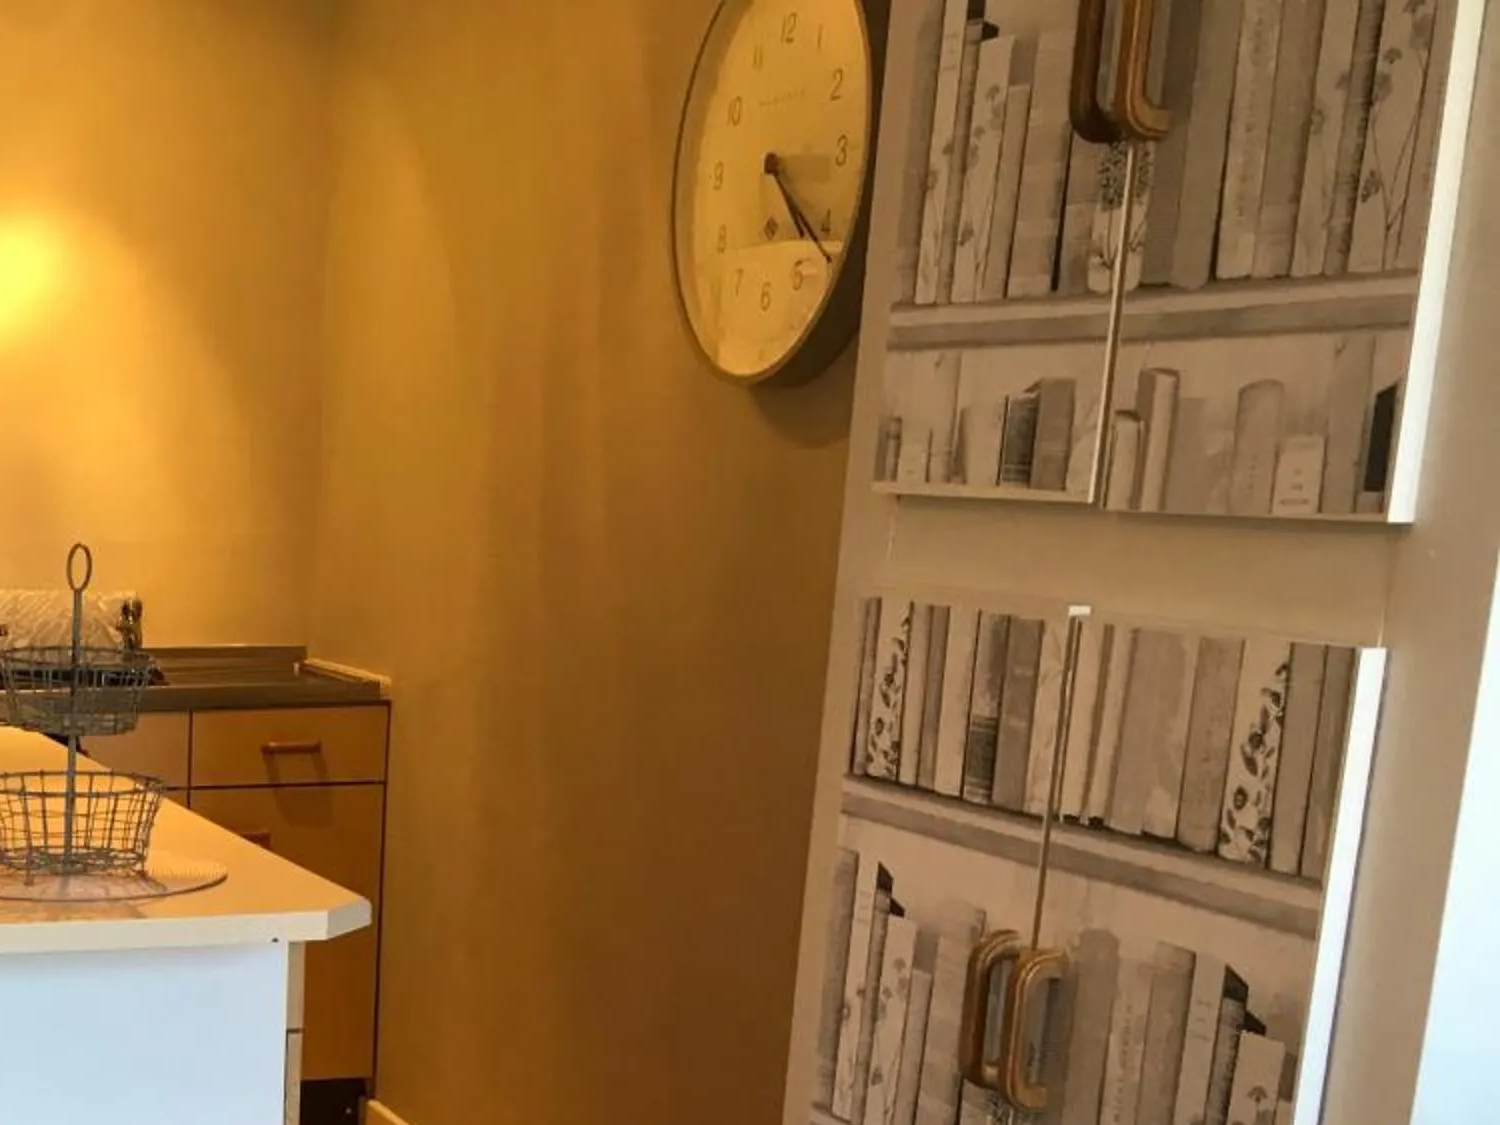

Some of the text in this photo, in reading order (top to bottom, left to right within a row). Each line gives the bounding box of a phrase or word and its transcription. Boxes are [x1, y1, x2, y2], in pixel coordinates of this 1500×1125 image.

[780, 12, 798, 44] 12
[752, 45, 764, 71] 11
[828, 67, 844, 102] 2
[726, 95, 744, 128] 10
[835, 133, 849, 167] 3
[712, 160, 725, 191] 9
[820, 207, 832, 236] 4
[716, 223, 728, 254] 8
[734, 266, 745, 298] 7
[792, 256, 812, 292] 5
[760, 281, 773, 312] 6
